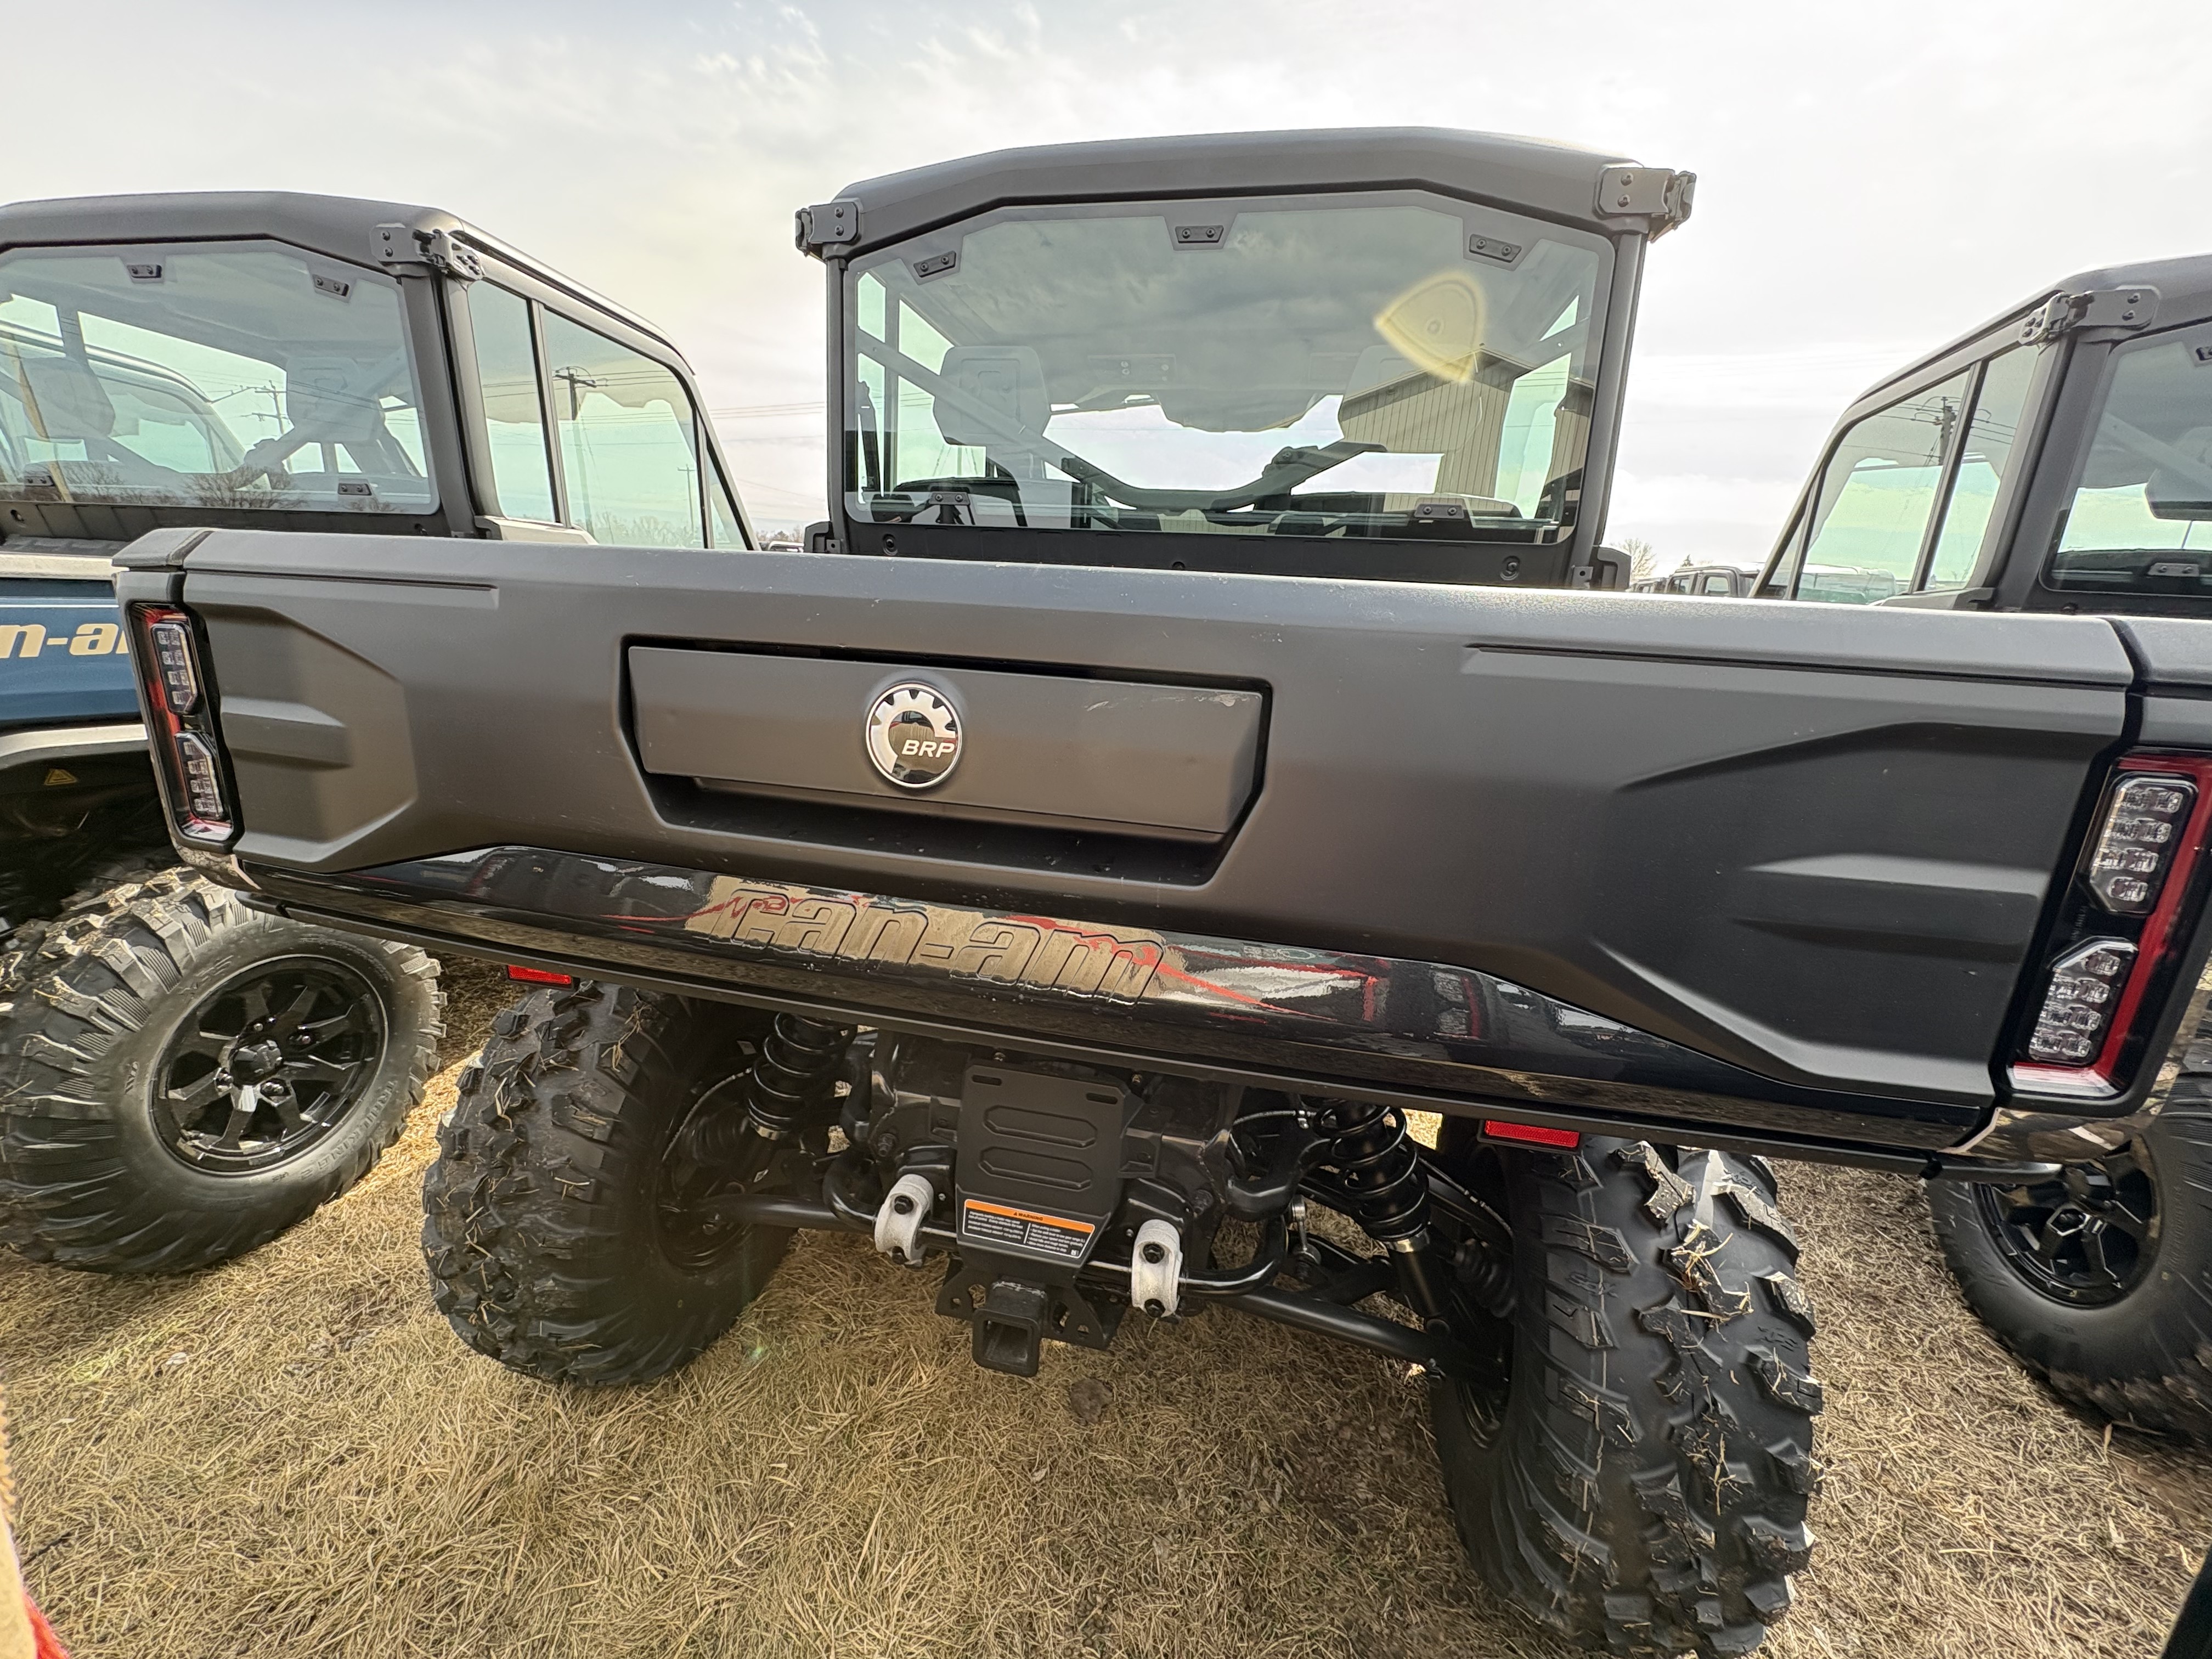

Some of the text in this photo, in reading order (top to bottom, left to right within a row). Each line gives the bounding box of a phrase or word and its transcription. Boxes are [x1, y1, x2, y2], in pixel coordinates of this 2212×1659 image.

[0, 623, 130, 658] n-a
[902, 740, 955, 758] BRP
[709, 889, 1164, 1008] can-am
[1019, 1212, 1043, 1221] WARNING
